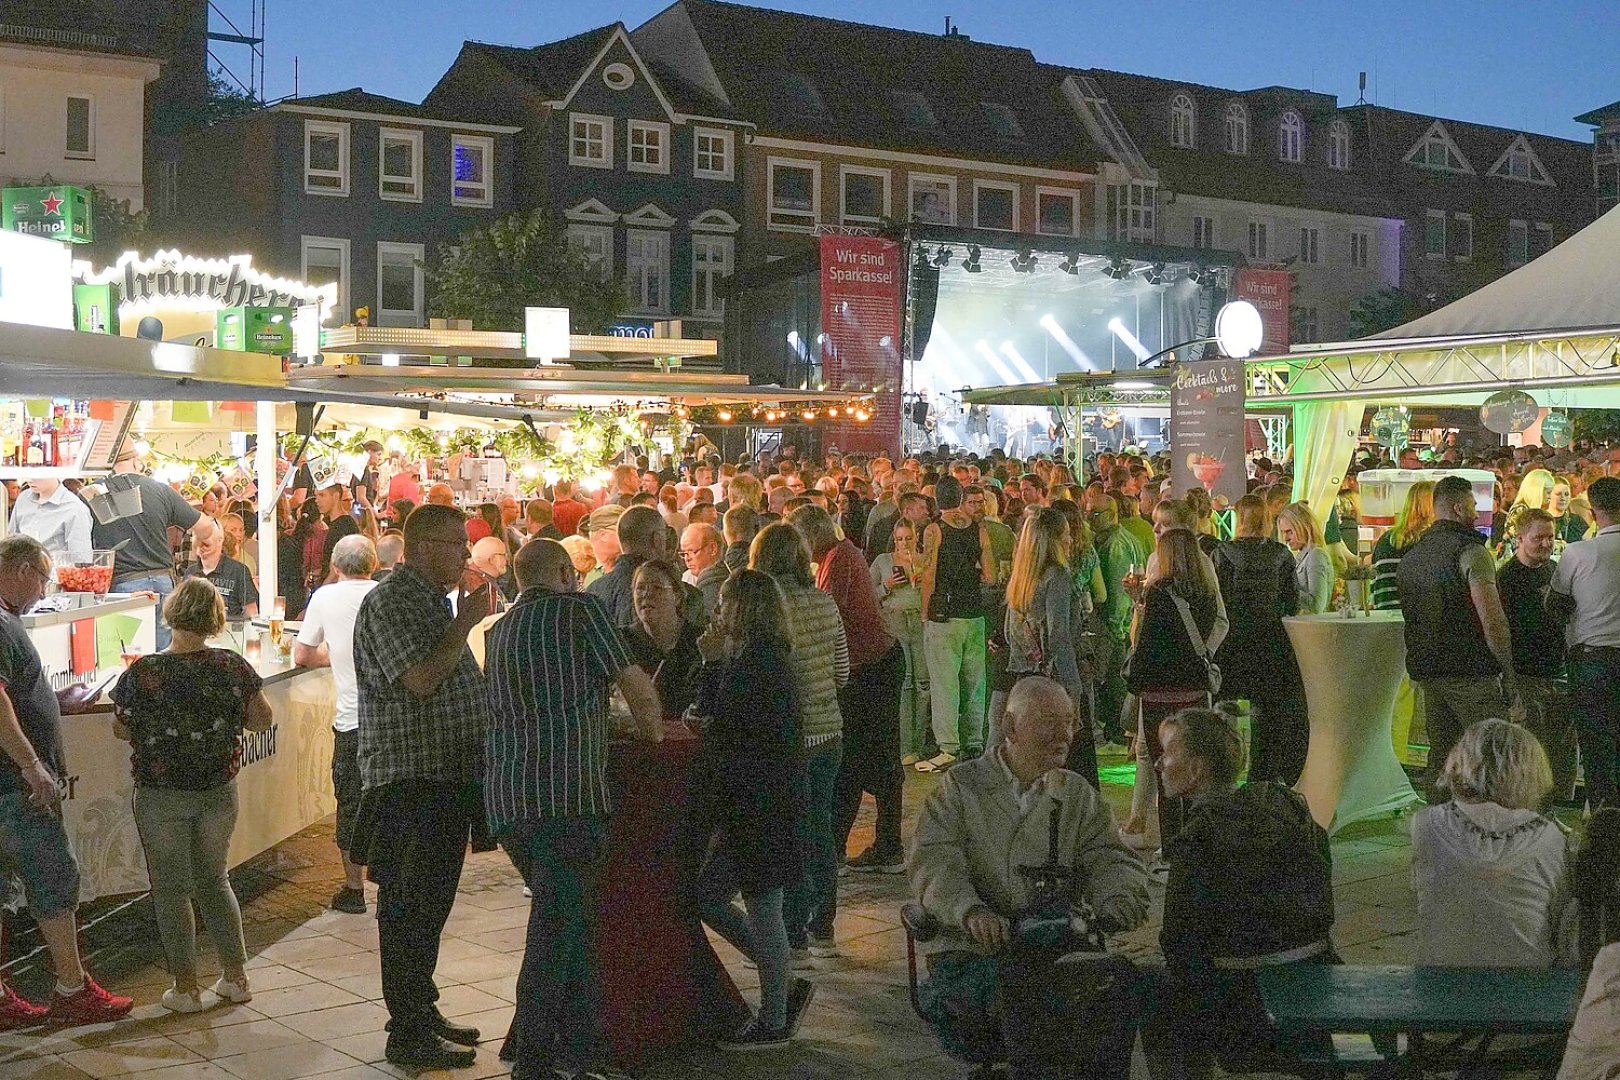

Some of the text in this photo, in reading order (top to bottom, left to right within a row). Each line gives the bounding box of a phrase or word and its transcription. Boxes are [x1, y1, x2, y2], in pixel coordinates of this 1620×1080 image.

[836, 249, 885, 266] Wir sind
[829, 266, 892, 284] Sparkasse!
[1261, 282, 1278, 296] sind
[1176, 368, 1218, 390] Cocktails
[1215, 383, 1239, 394] more
